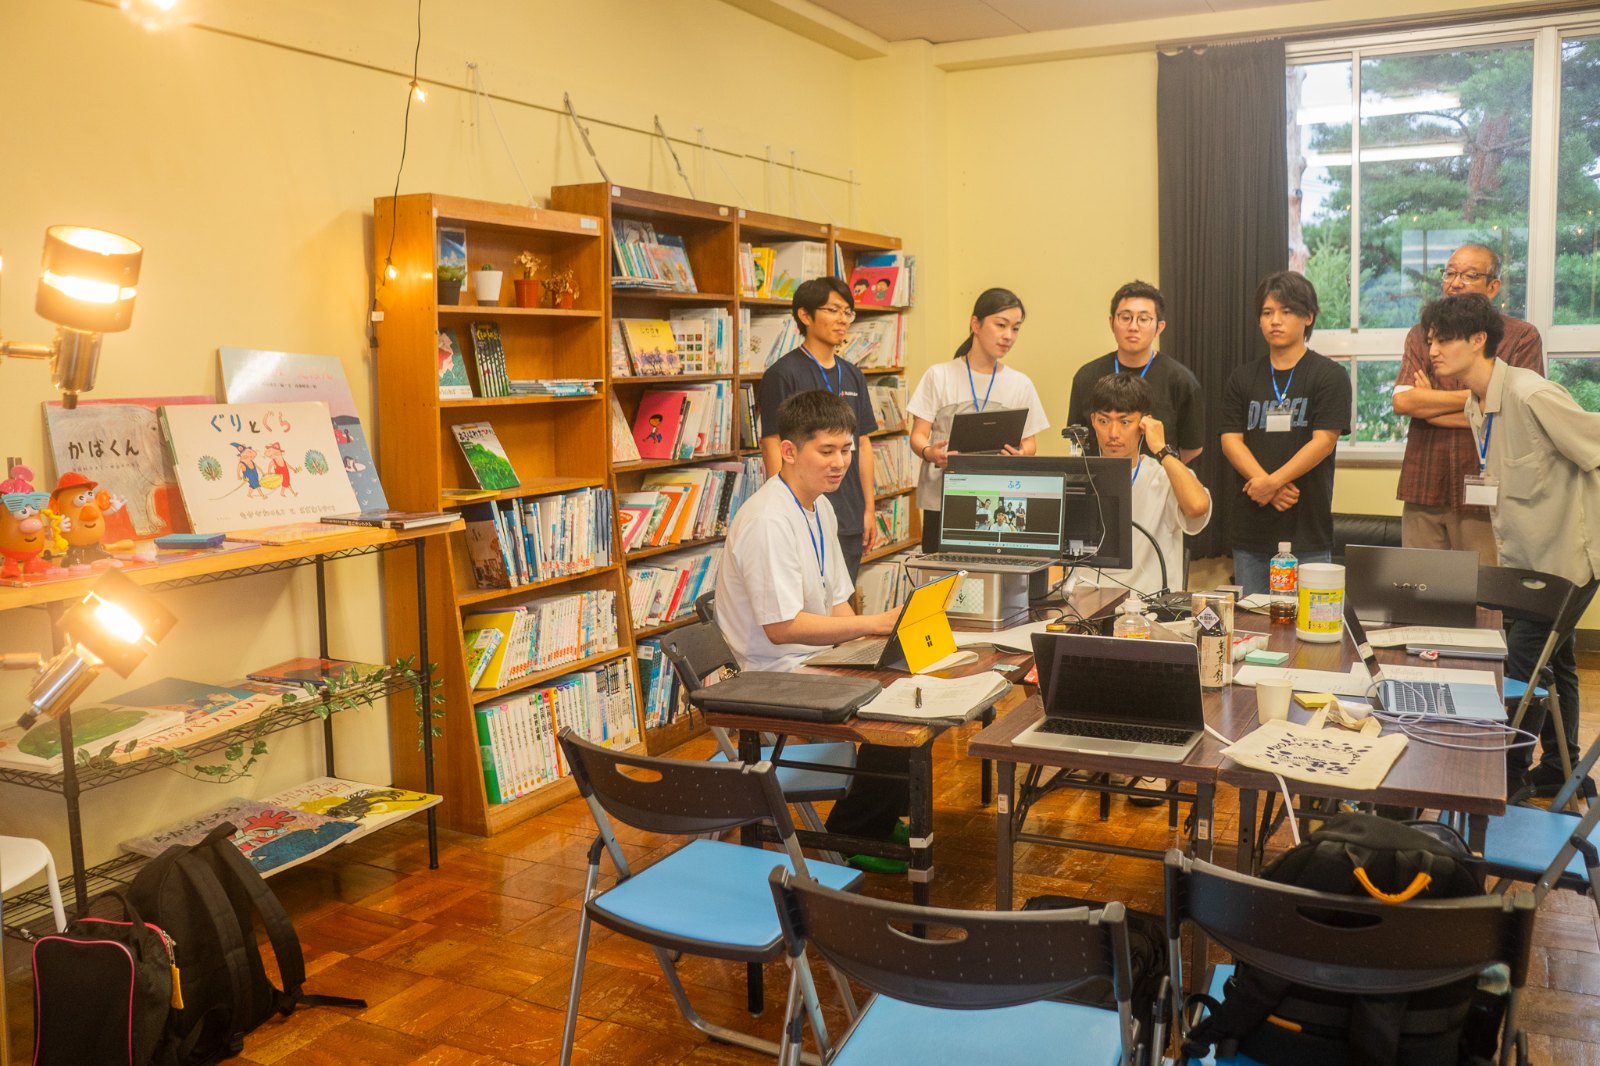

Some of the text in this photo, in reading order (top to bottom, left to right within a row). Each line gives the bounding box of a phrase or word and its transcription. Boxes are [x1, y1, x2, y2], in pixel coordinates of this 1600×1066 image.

[210, 410, 292, 433] ぐりとぐら
[68, 439, 139, 459] かばくん
